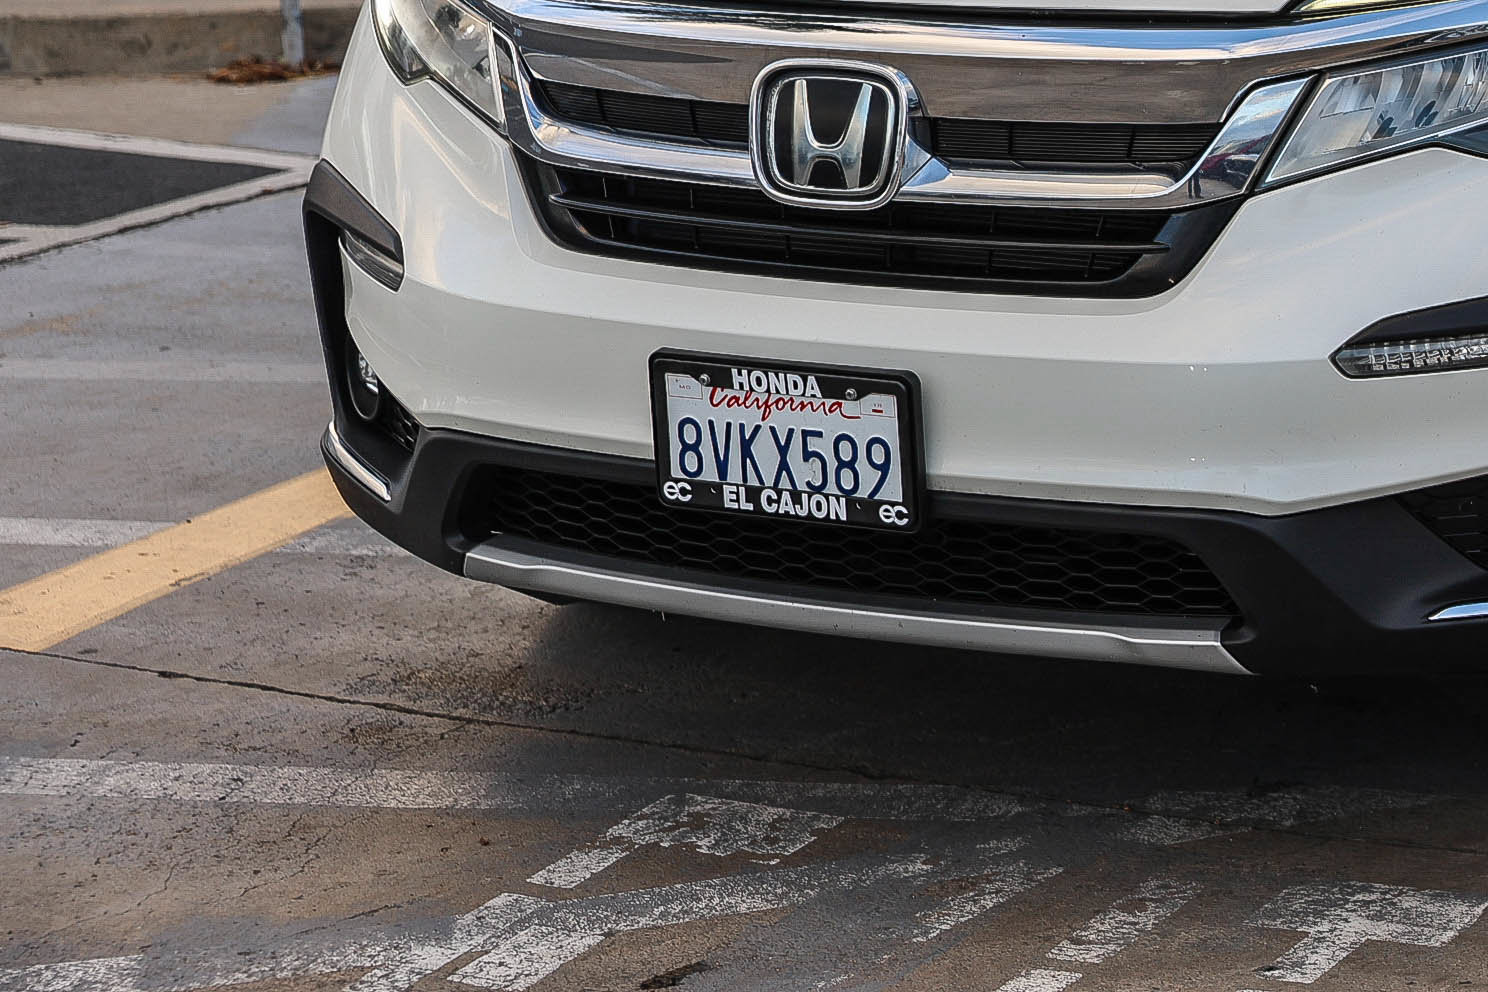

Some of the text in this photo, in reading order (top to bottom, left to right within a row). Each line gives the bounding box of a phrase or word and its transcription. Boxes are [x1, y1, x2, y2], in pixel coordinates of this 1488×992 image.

[730, 367, 823, 399] HONDA
[709, 385, 862, 422] California
[677, 416, 892, 500] 8VKX589
[722, 485, 848, 522] EL CAJON
